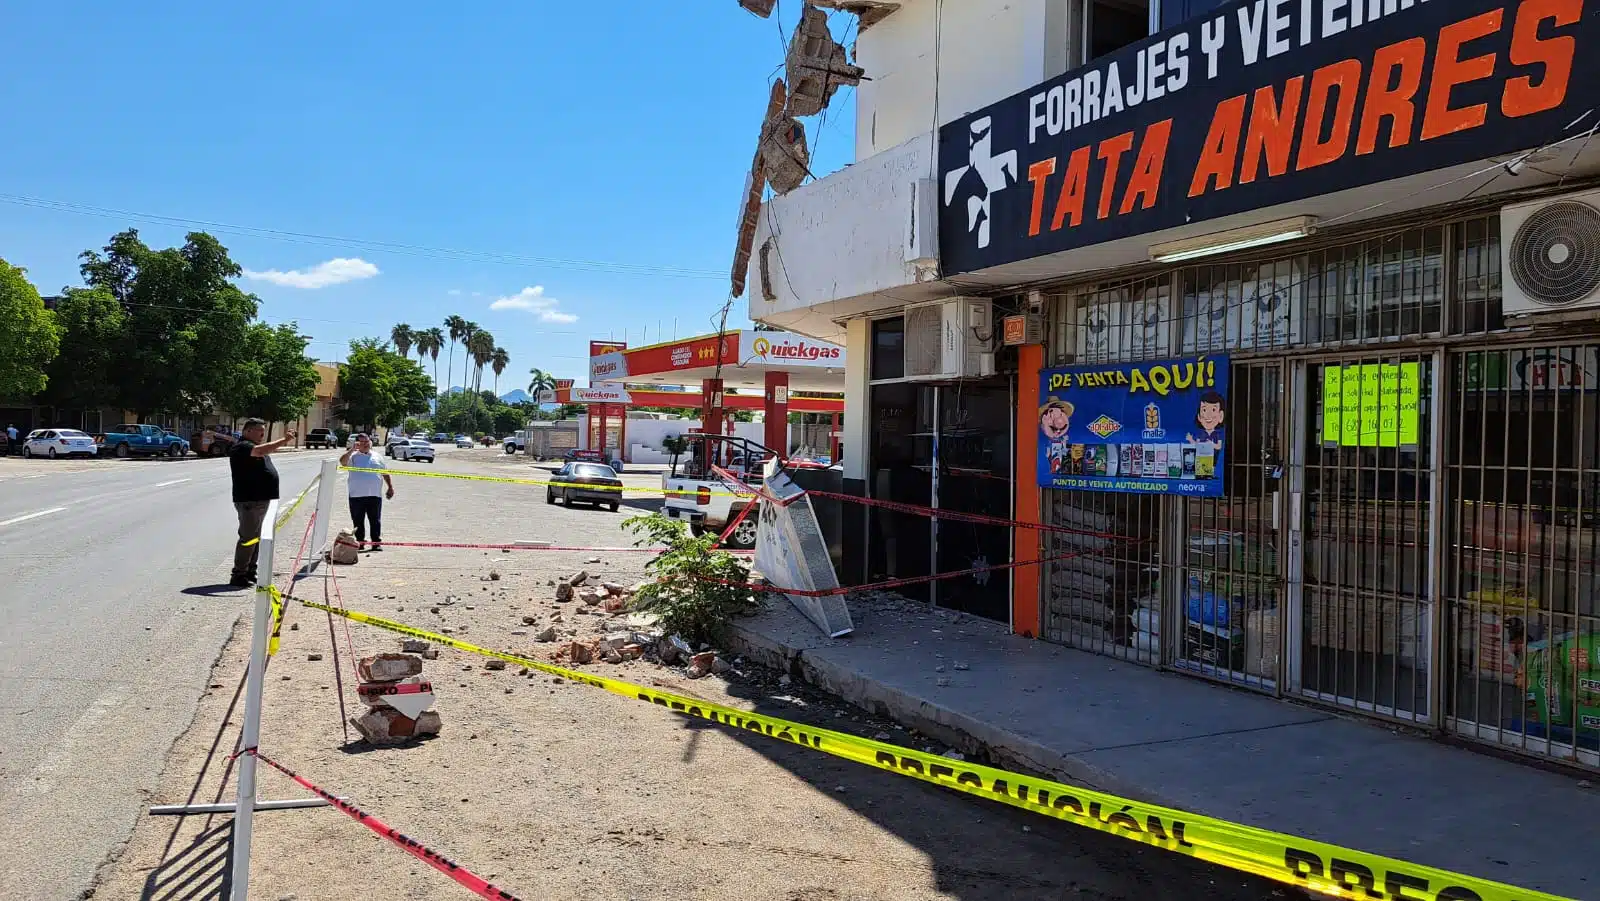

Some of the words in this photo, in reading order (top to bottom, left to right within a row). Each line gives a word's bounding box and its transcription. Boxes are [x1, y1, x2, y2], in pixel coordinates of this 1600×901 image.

[1029, 32, 1189, 144] FORRAJES
[1202, 16, 1225, 80] Y
[1237, 0, 1431, 66] VETE
[1028, 118, 1172, 236] TATA
[1187, 0, 1583, 198] ANDRES
[753, 337, 840, 361] Quickgas
[1048, 373, 1072, 392] ¡DE
[1074, 370, 1129, 387] VENTA
[1130, 355, 1215, 396] AQUÍ!
[577, 390, 619, 399] Quickgas
[1053, 478, 1077, 486] PUNTO
[1088, 480, 1113, 489] VENTA
[1115, 481, 1168, 491] AUTORIZADO
